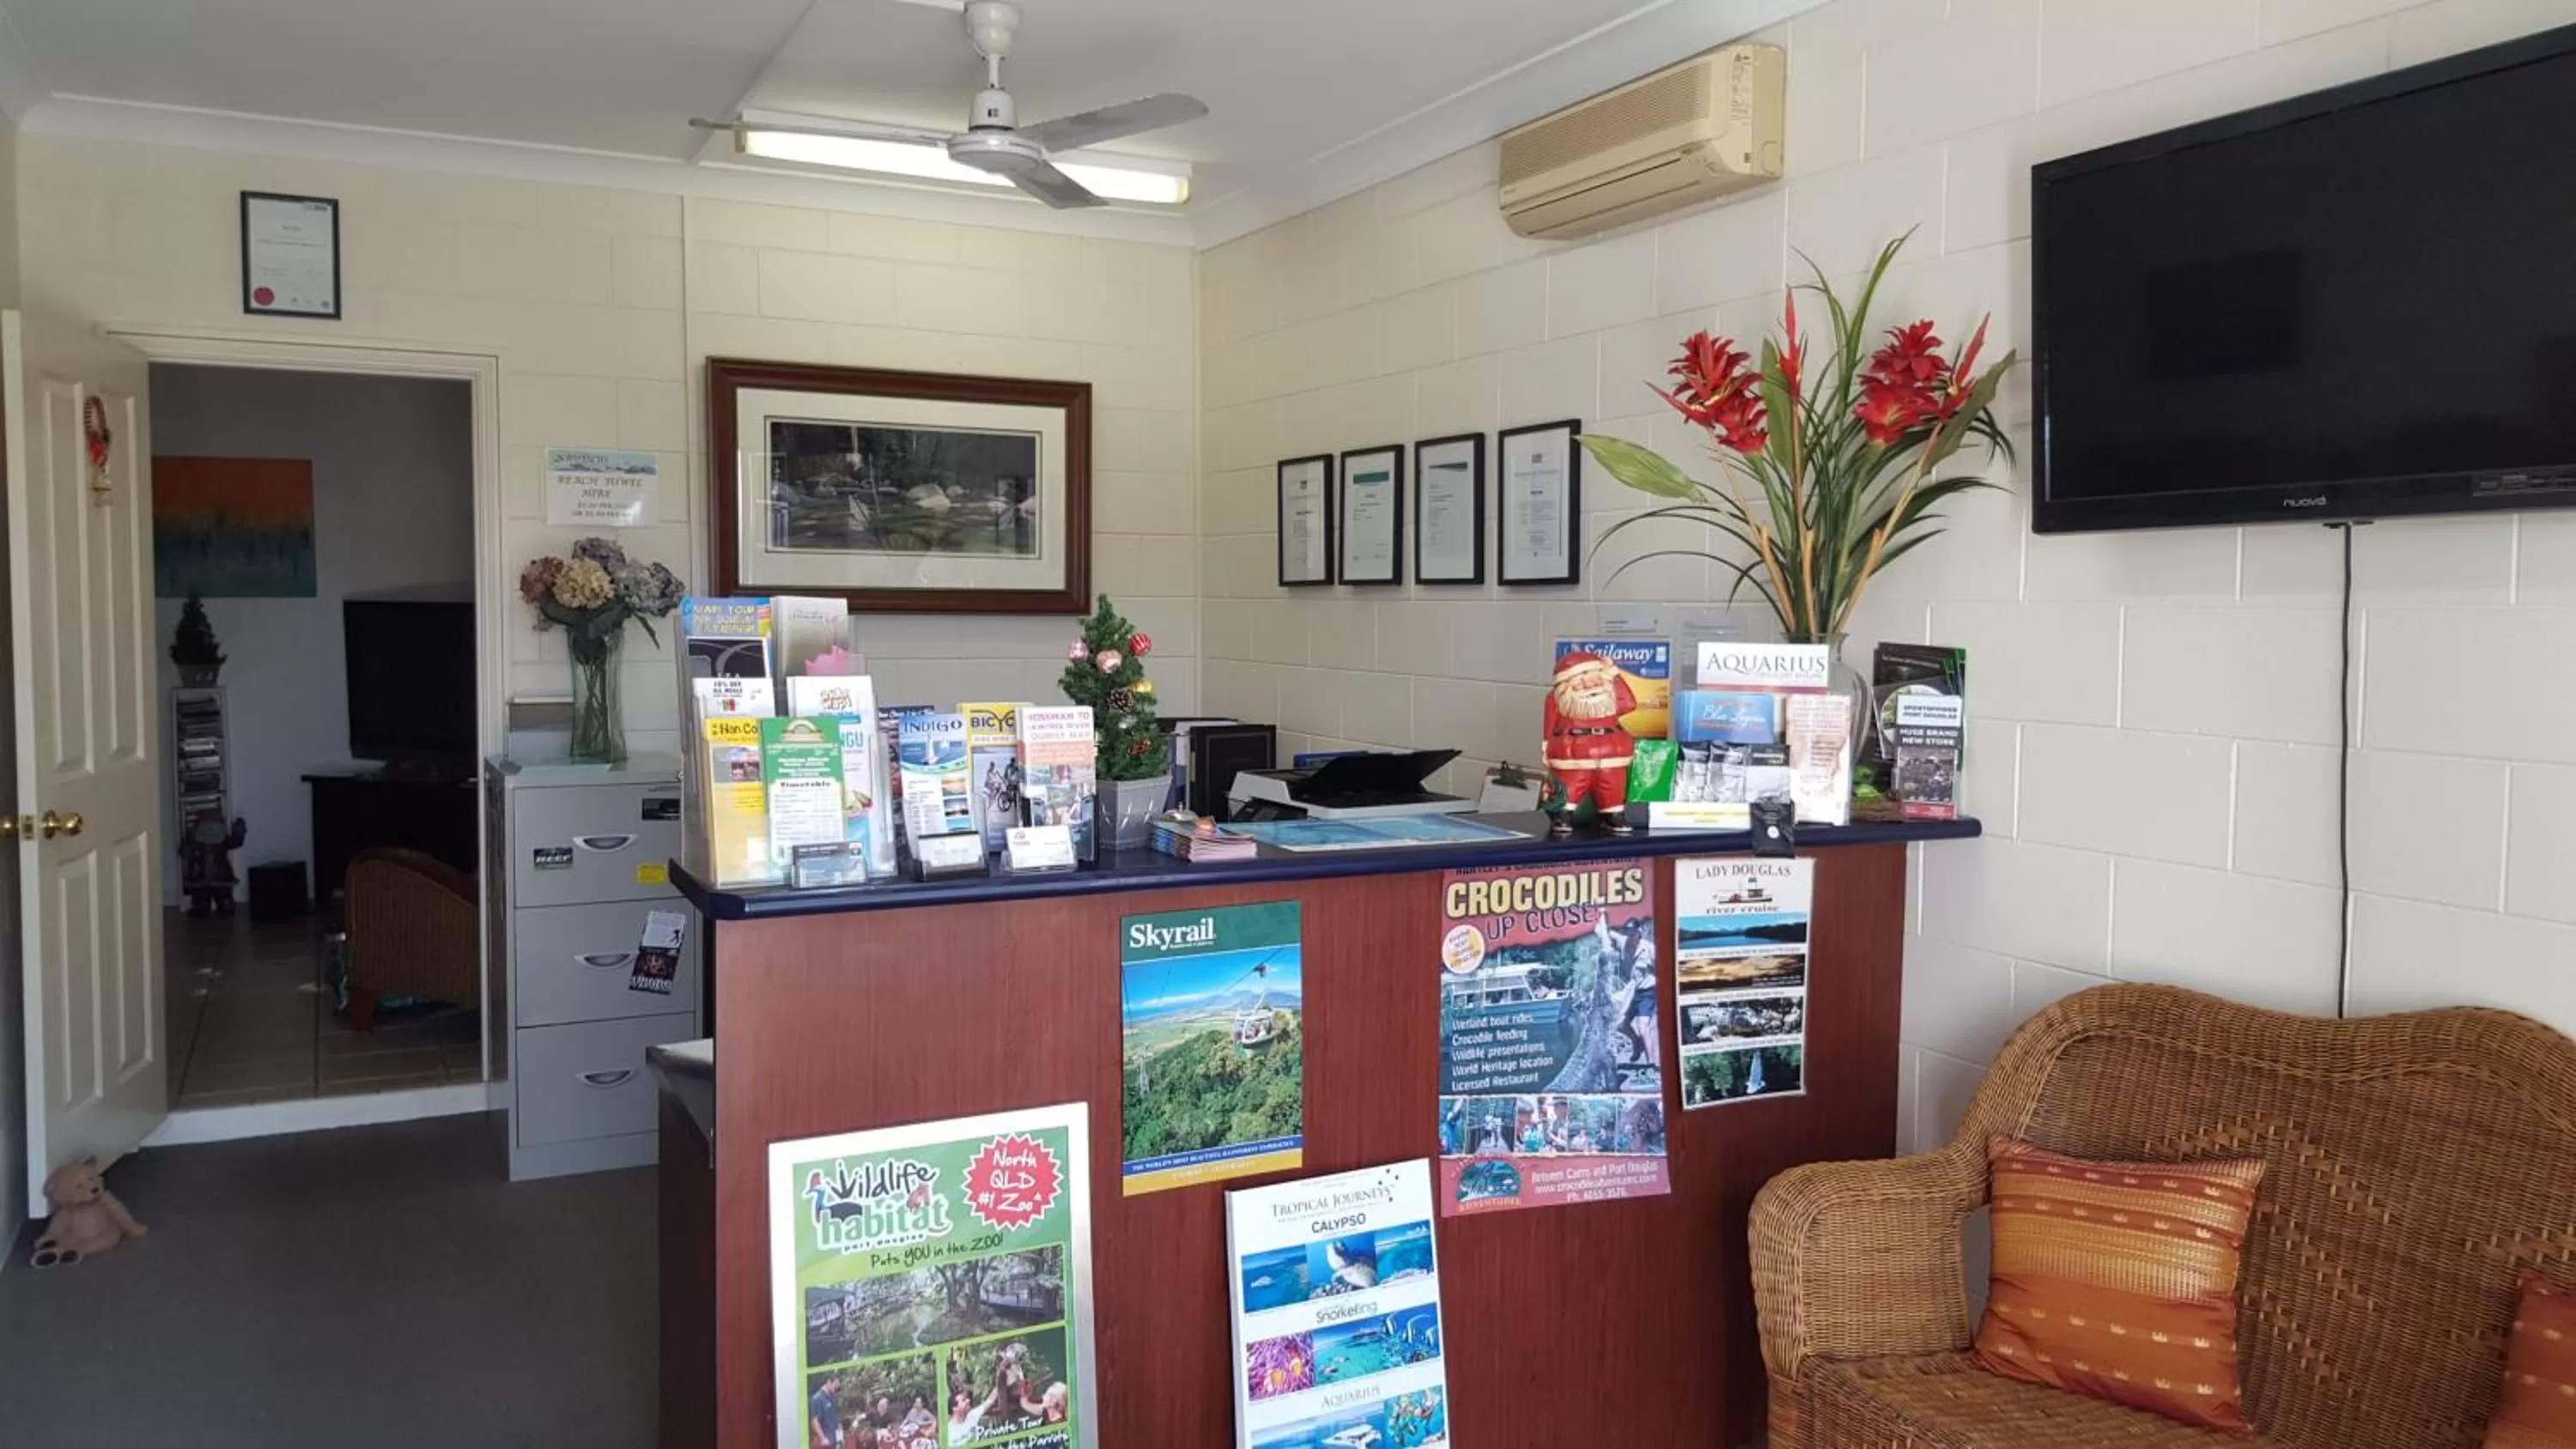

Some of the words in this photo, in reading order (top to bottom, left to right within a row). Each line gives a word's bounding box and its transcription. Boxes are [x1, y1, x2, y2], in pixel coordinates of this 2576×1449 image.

[1584, 643, 1654, 664] Sailaway
[1705, 652, 1826, 676] AQUARIUS
[903, 719, 963, 734] INDIGO
[1901, 737, 1924, 745] NEW
[1925, 737, 1956, 746] STORE
[1696, 865, 1729, 879] LADY
[1732, 864, 1791, 877] DOUGLAS
[1446, 868, 1643, 918] CROCODILES
[1129, 917, 1214, 951] Skyrail
[1486, 913, 1516, 940] UP
[1490, 1016, 1510, 1027] boat
[1452, 1031, 1493, 1046] Crocodile
[1496, 1029, 1528, 1041] feeding
[1487, 1041, 1546, 1058] presentations
[1452, 1064, 1479, 1077] World
[1481, 1061, 1518, 1073] Heritage
[1519, 1057, 1553, 1069] location
[1452, 1077, 1491, 1092] Licensed
[1492, 1072, 1539, 1087] Restaurant
[993, 1147, 1037, 1168] North
[1608, 1163, 1626, 1174] Port
[1627, 1161, 1658, 1174] Douglas
[830, 1161, 937, 1200] Wildlife
[990, 1169, 1036, 1189] QLD
[977, 1190, 996, 1210] #1
[1272, 1197, 1330, 1218] TROPICAL
[1332, 1185, 1392, 1209] JOURNEYS
[821, 1195, 950, 1246] habitat
[1311, 1212, 1367, 1234] CALYPSO
[871, 1252, 901, 1268] Puts
[933, 1245, 944, 1258] in
[946, 1242, 968, 1256] the
[1315, 1301, 1378, 1325] Snorkeling
[975, 1419, 1018, 1442] Private
[1018, 1415, 1044, 1429] Tour
